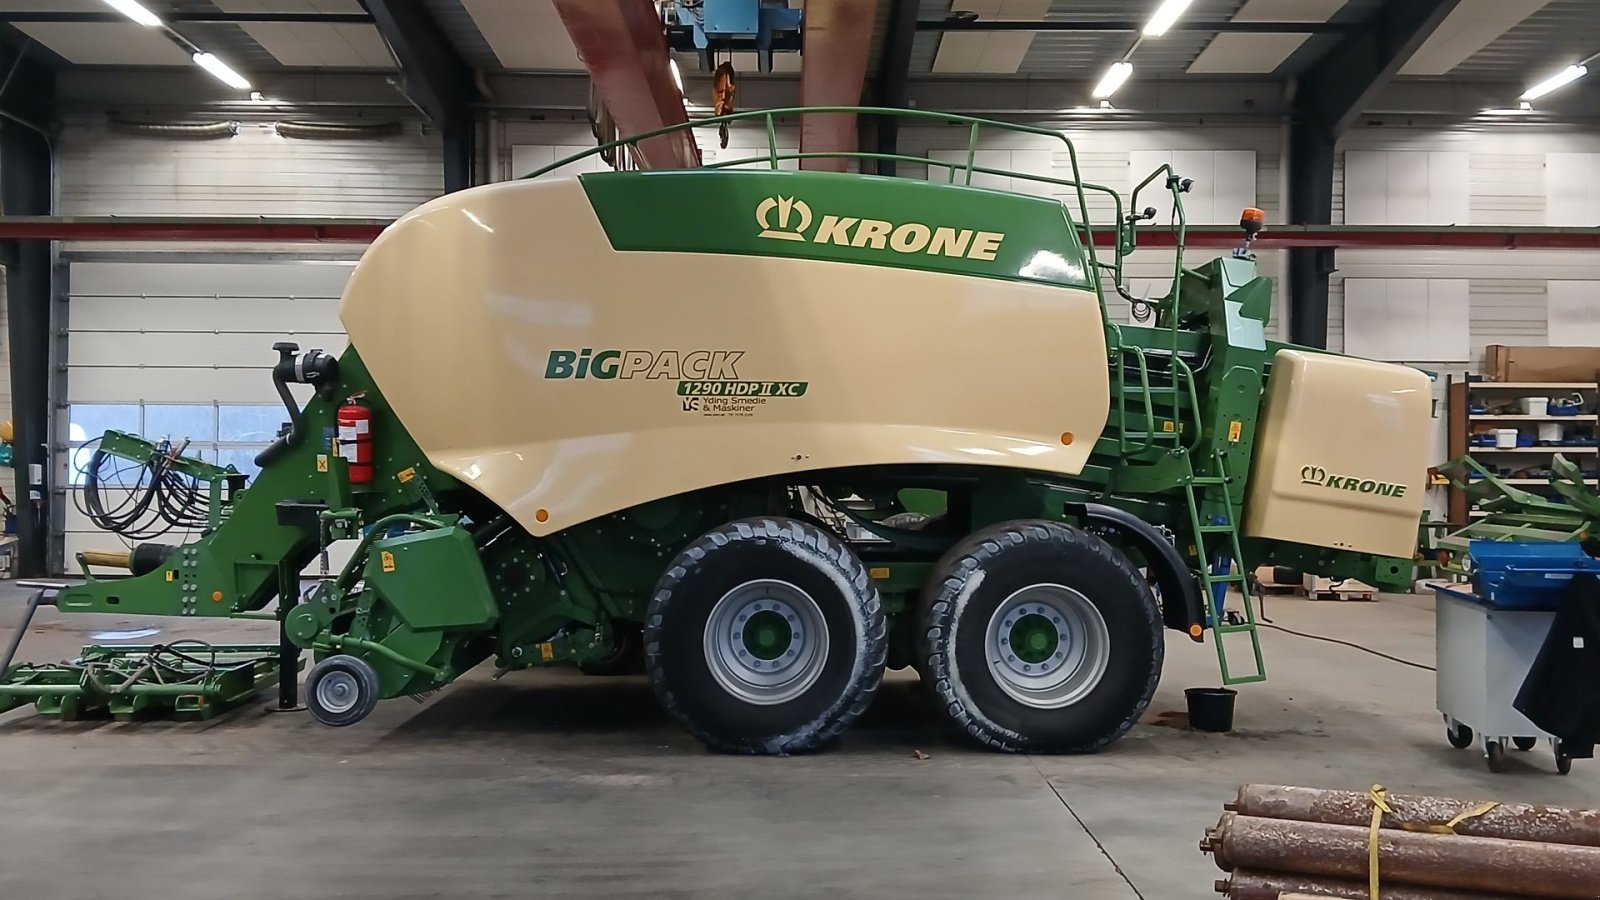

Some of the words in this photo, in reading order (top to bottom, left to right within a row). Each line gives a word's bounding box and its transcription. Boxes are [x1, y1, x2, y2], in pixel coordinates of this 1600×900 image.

[813, 215, 1005, 261] KRONE
[684, 382, 722, 395] 1290
[775, 383, 800, 395] XC
[703, 397, 728, 405] Yding
[1325, 475, 1407, 498] KRONE
